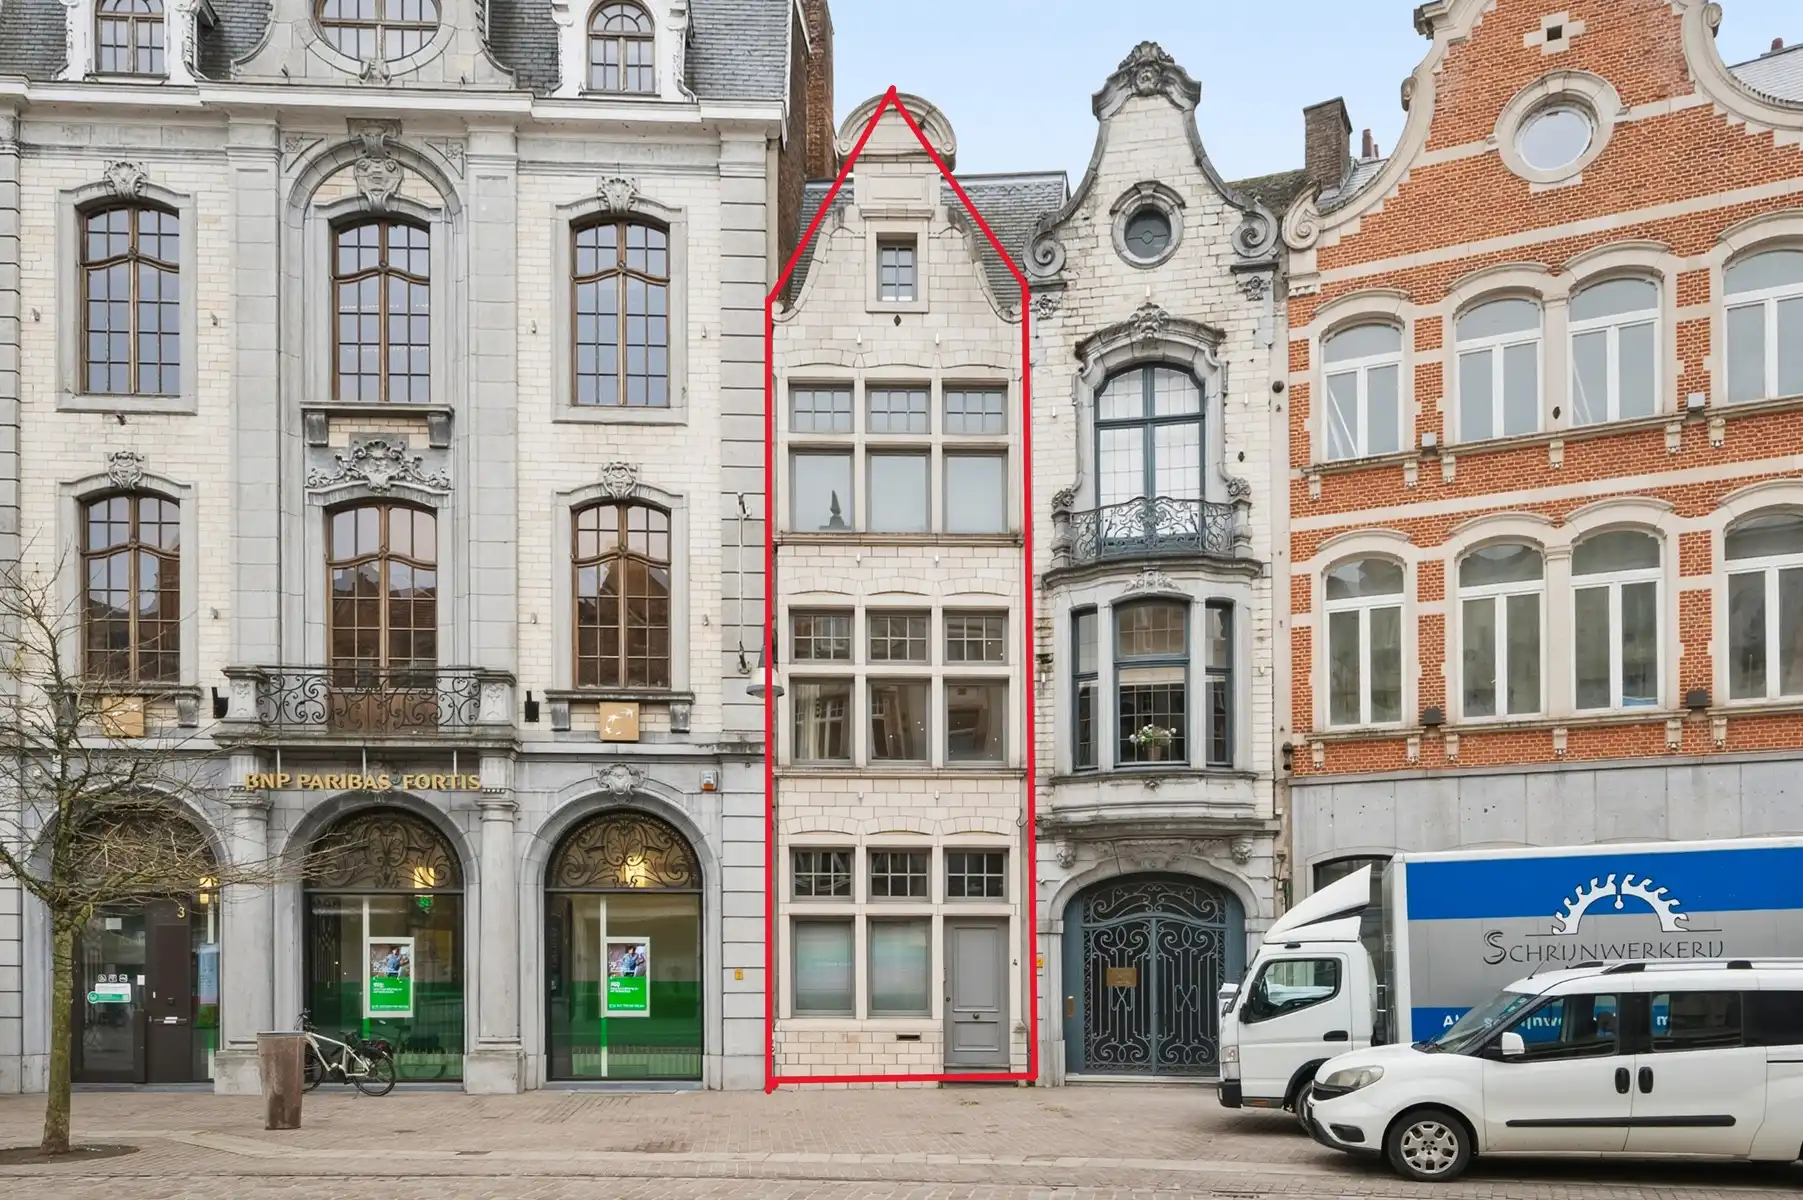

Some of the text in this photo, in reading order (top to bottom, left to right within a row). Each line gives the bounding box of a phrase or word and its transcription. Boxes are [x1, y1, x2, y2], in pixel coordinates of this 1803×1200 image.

[245, 773, 481, 790] BNP PARIBAS FORTIS
[177, 906, 185, 918] 3
[1483, 930, 1724, 965] SCHRIJNWERKERIJ
